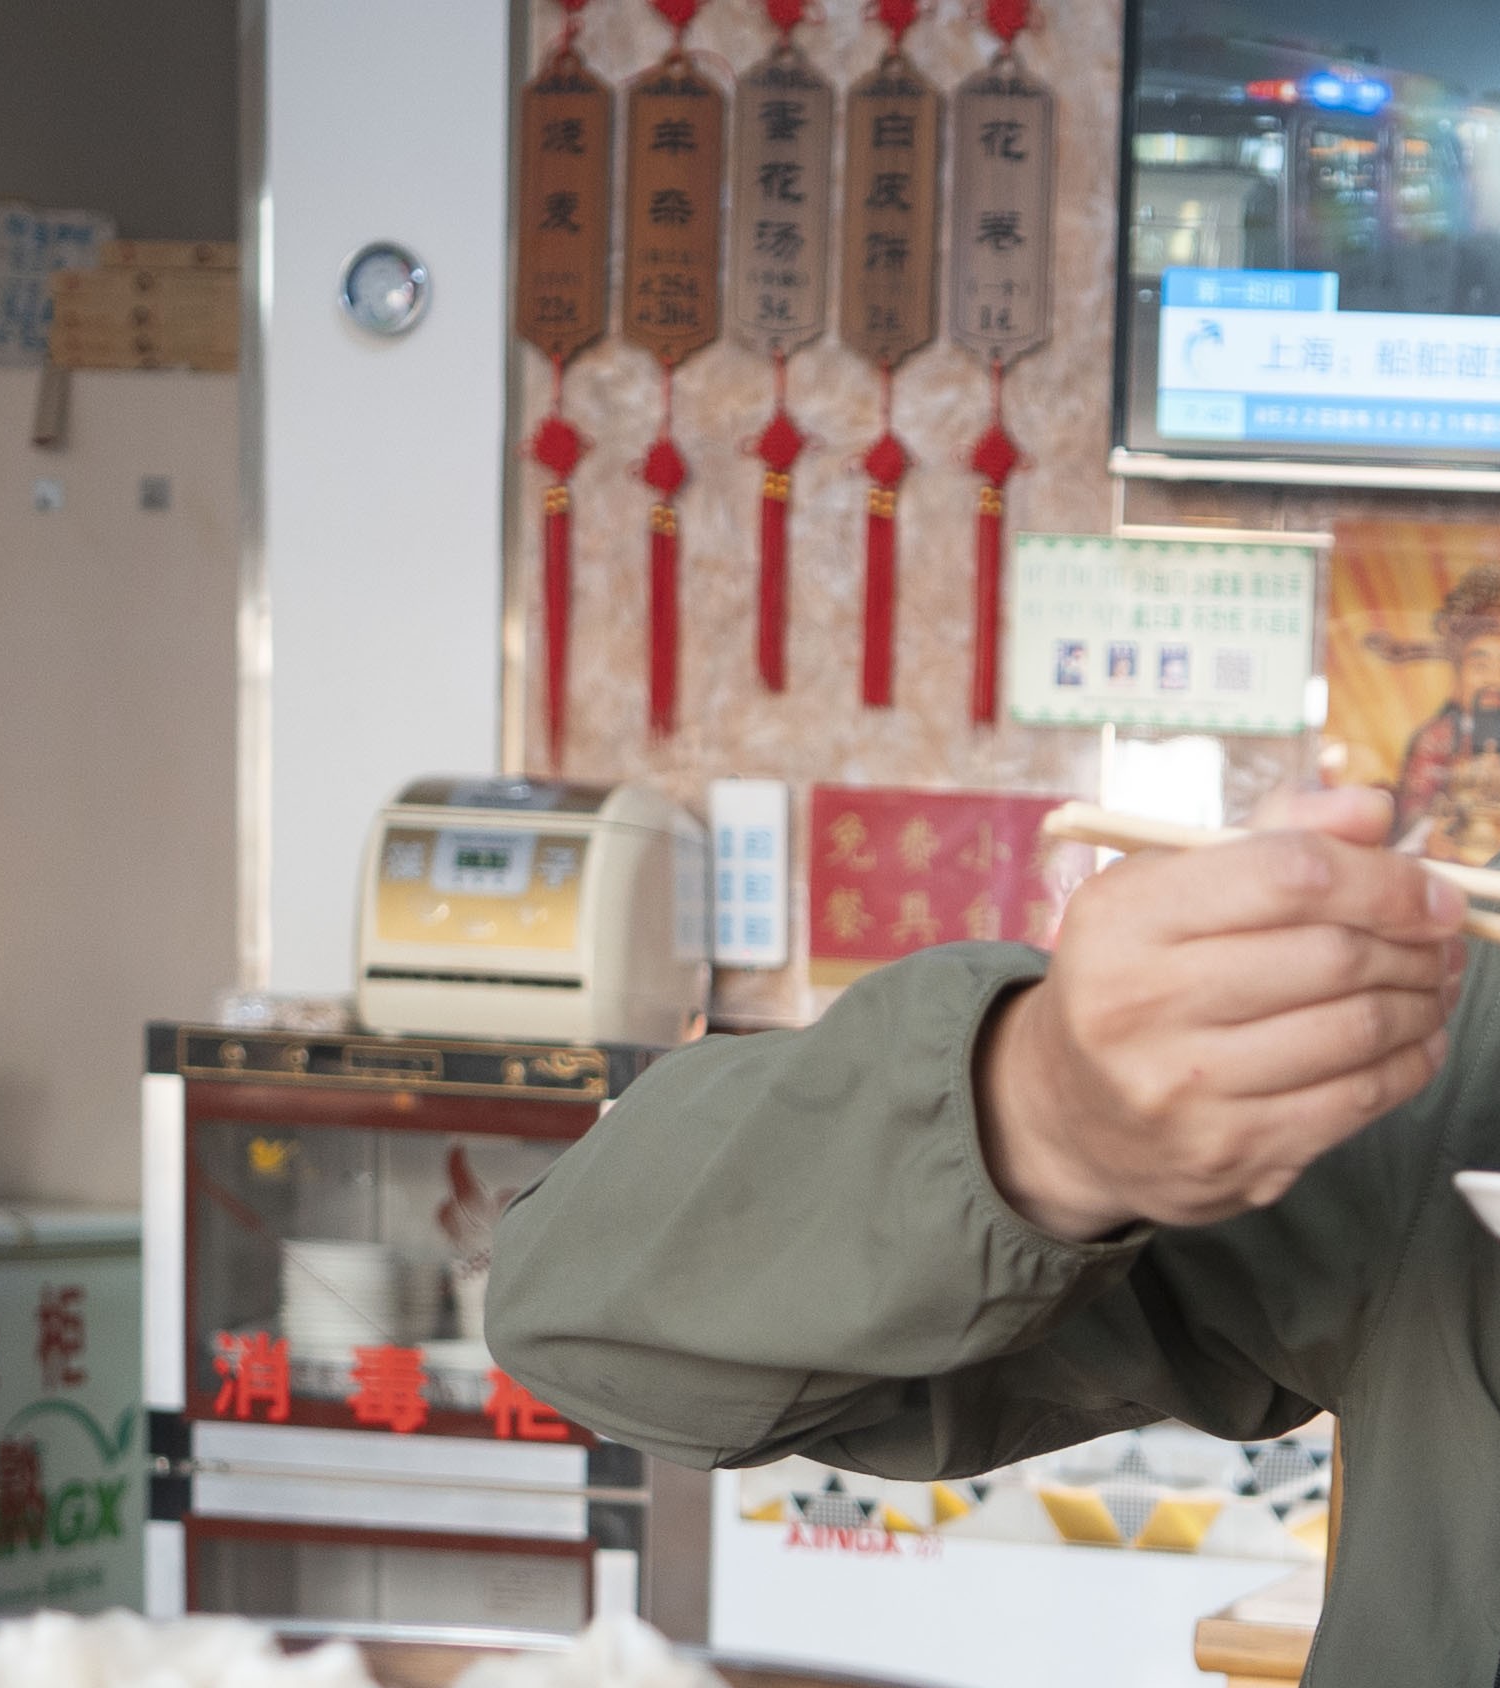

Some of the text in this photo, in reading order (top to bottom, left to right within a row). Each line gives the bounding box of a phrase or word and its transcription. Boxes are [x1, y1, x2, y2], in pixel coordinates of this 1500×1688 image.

[755, 101, 806, 260] 蛋花汤
[865, 111, 915, 270] 白皮饼
[976, 119, 1027, 250] 花卷
